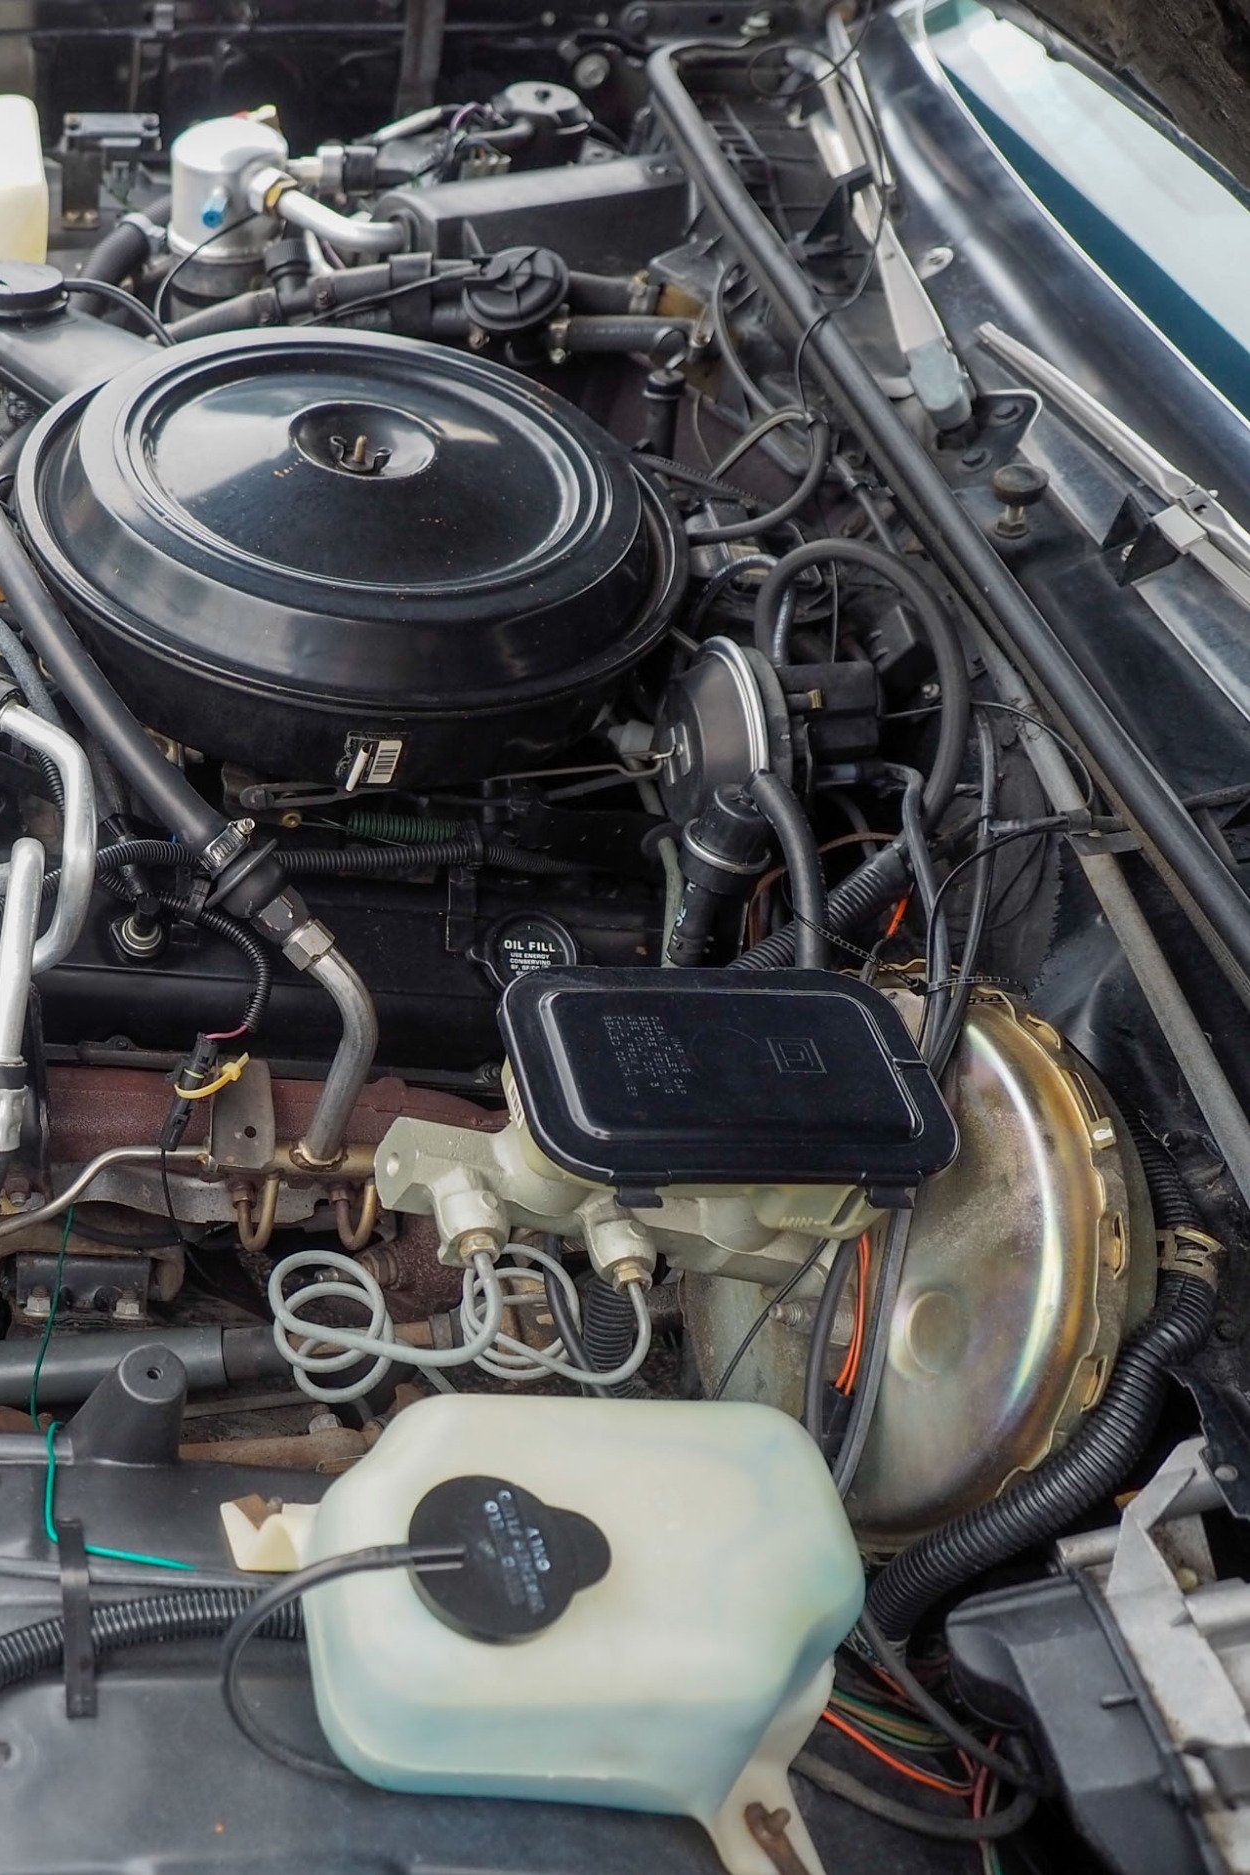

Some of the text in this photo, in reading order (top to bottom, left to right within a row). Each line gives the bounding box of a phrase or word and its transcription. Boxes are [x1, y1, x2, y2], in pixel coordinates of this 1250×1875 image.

[504, 940, 556, 953] OIL FILL
[510, 958, 552, 966] CONSERVING
